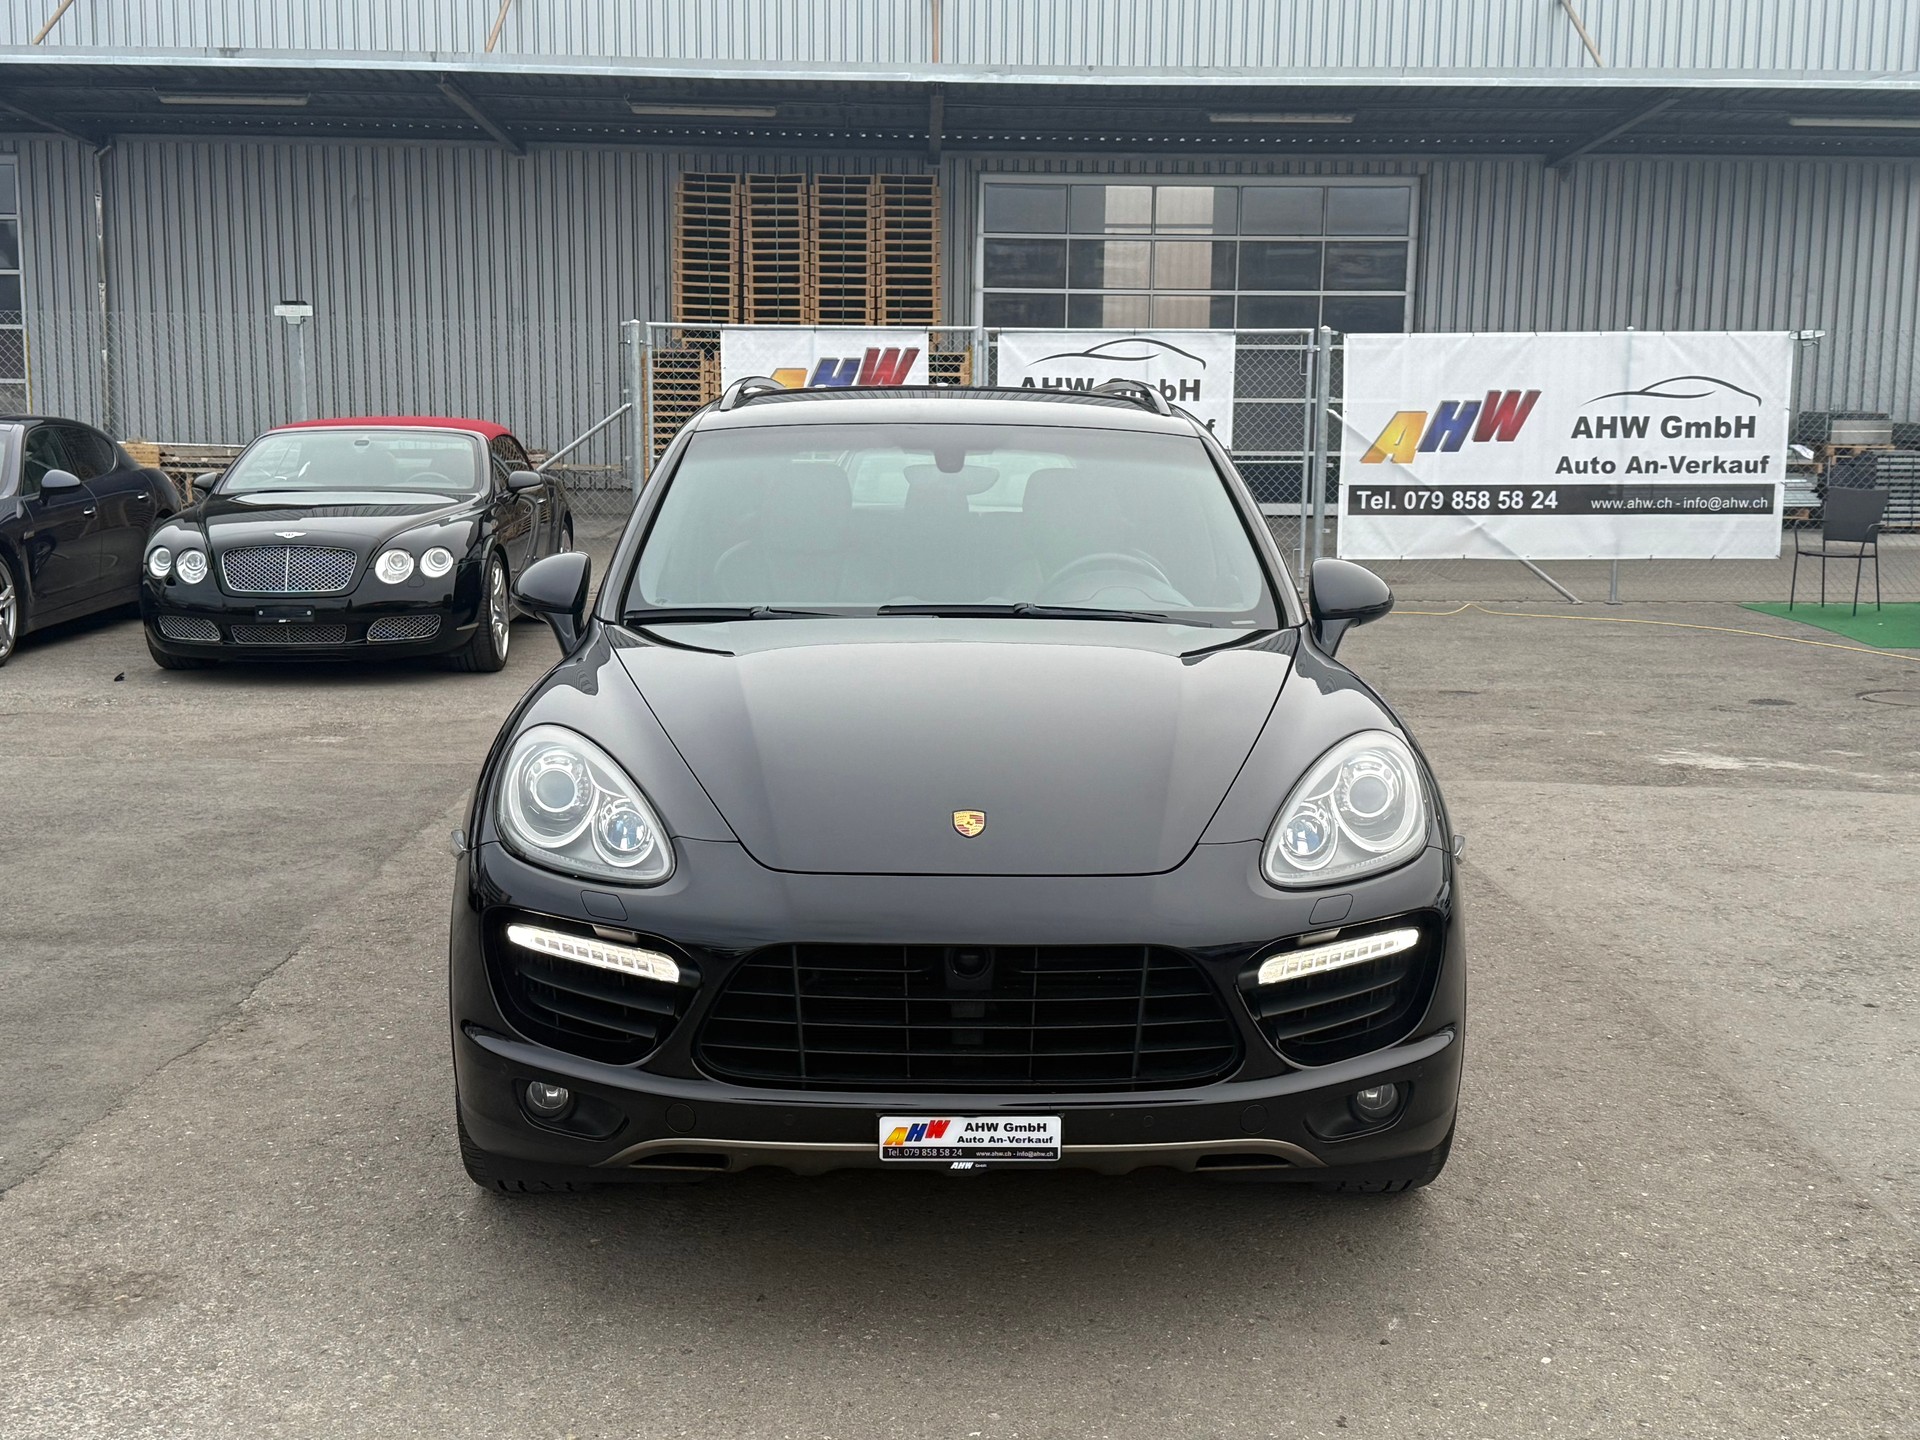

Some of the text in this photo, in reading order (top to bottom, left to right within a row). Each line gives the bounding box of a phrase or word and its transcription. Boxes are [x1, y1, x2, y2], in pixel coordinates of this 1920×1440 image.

[1360, 390, 1542, 463] AHW
[1571, 415, 1756, 439] AHW GmbH
[1555, 455, 1770, 474] Auto An-Verkauf
[1356, 490, 1558, 510] Tel. 079 858 58 24
[1591, 497, 1672, 509] www.ahw.ch
[1683, 496, 1768, 511] info@ahw.ch
[883, 1120, 951, 1145] AHW
[964, 1122, 1047, 1132] AHW GmbH
[957, 1136, 1053, 1144] Auto An-Verkauf
[887, 1148, 963, 1156] Tel. 079 858 58 24
